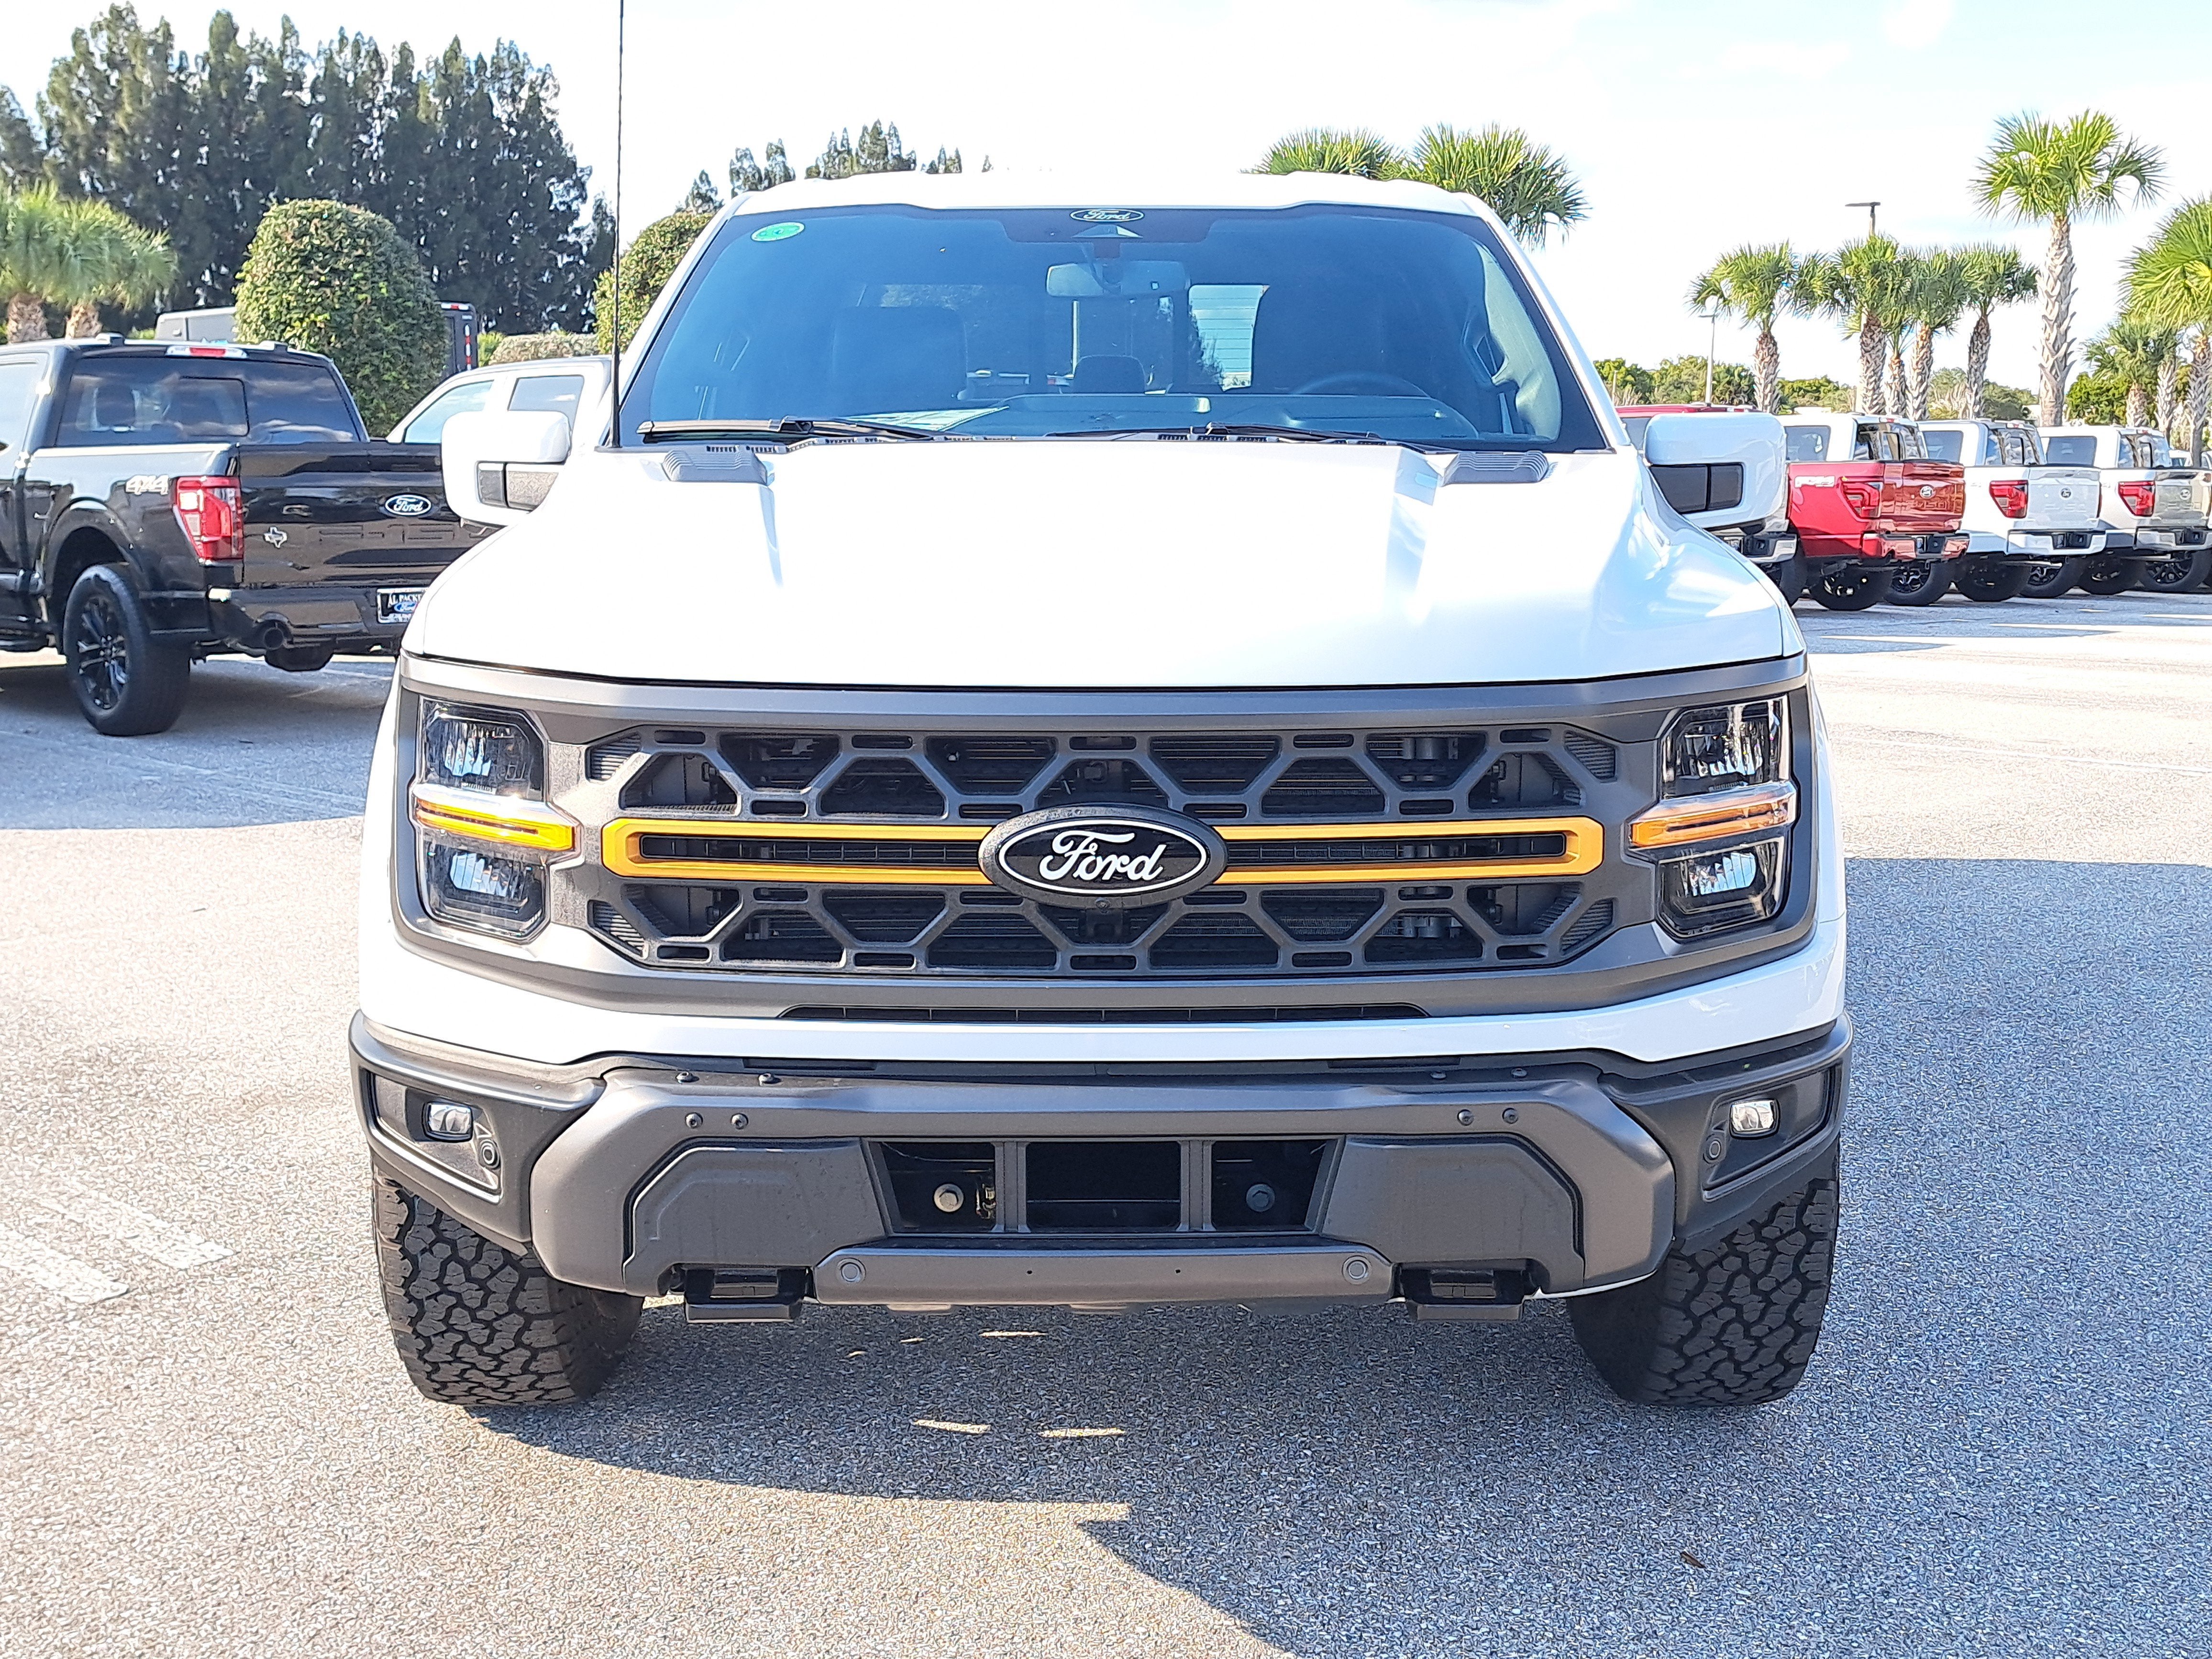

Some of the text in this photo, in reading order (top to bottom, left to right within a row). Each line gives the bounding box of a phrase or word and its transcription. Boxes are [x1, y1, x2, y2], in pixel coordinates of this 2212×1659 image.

[1083, 210, 1131, 220] Ford
[393, 498, 424, 512] Ford
[1039, 830, 1169, 882] Ford
